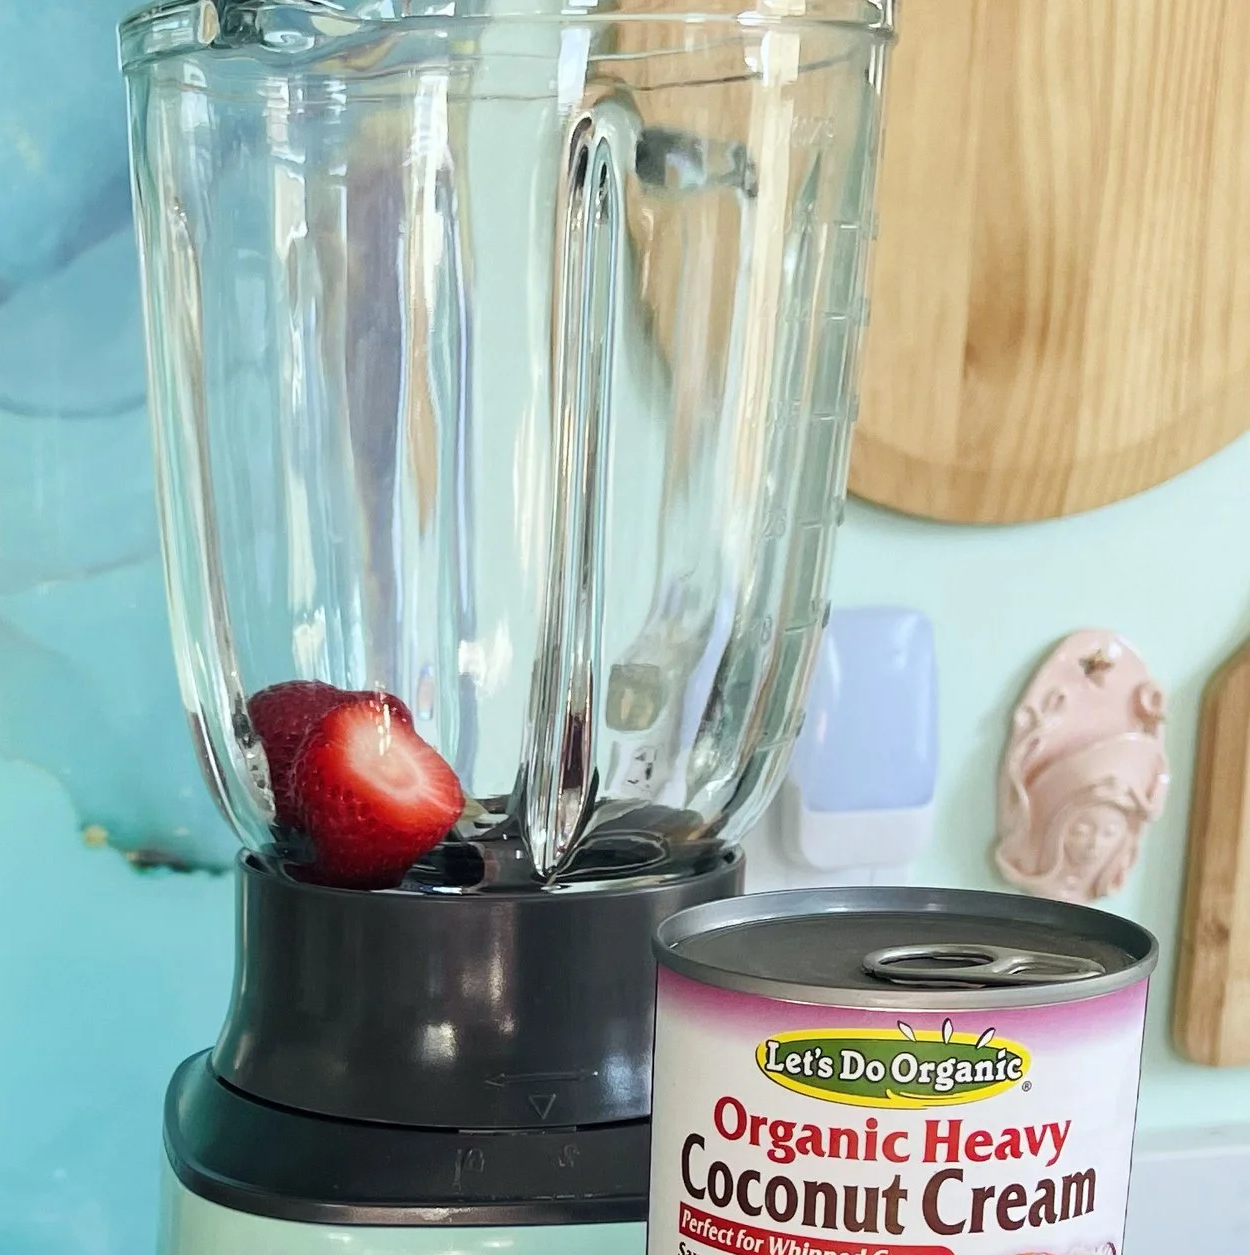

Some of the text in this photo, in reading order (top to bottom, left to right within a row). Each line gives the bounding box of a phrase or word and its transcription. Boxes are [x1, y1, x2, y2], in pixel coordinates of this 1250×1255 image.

[764, 1040, 1023, 1092] Let's Do Organic
[713, 1096, 1072, 1167] Organic Heavy
[681, 1133, 1096, 1236] Coconut Cream
[682, 1210, 734, 1246] Perfect
[735, 1231, 764, 1253] for
